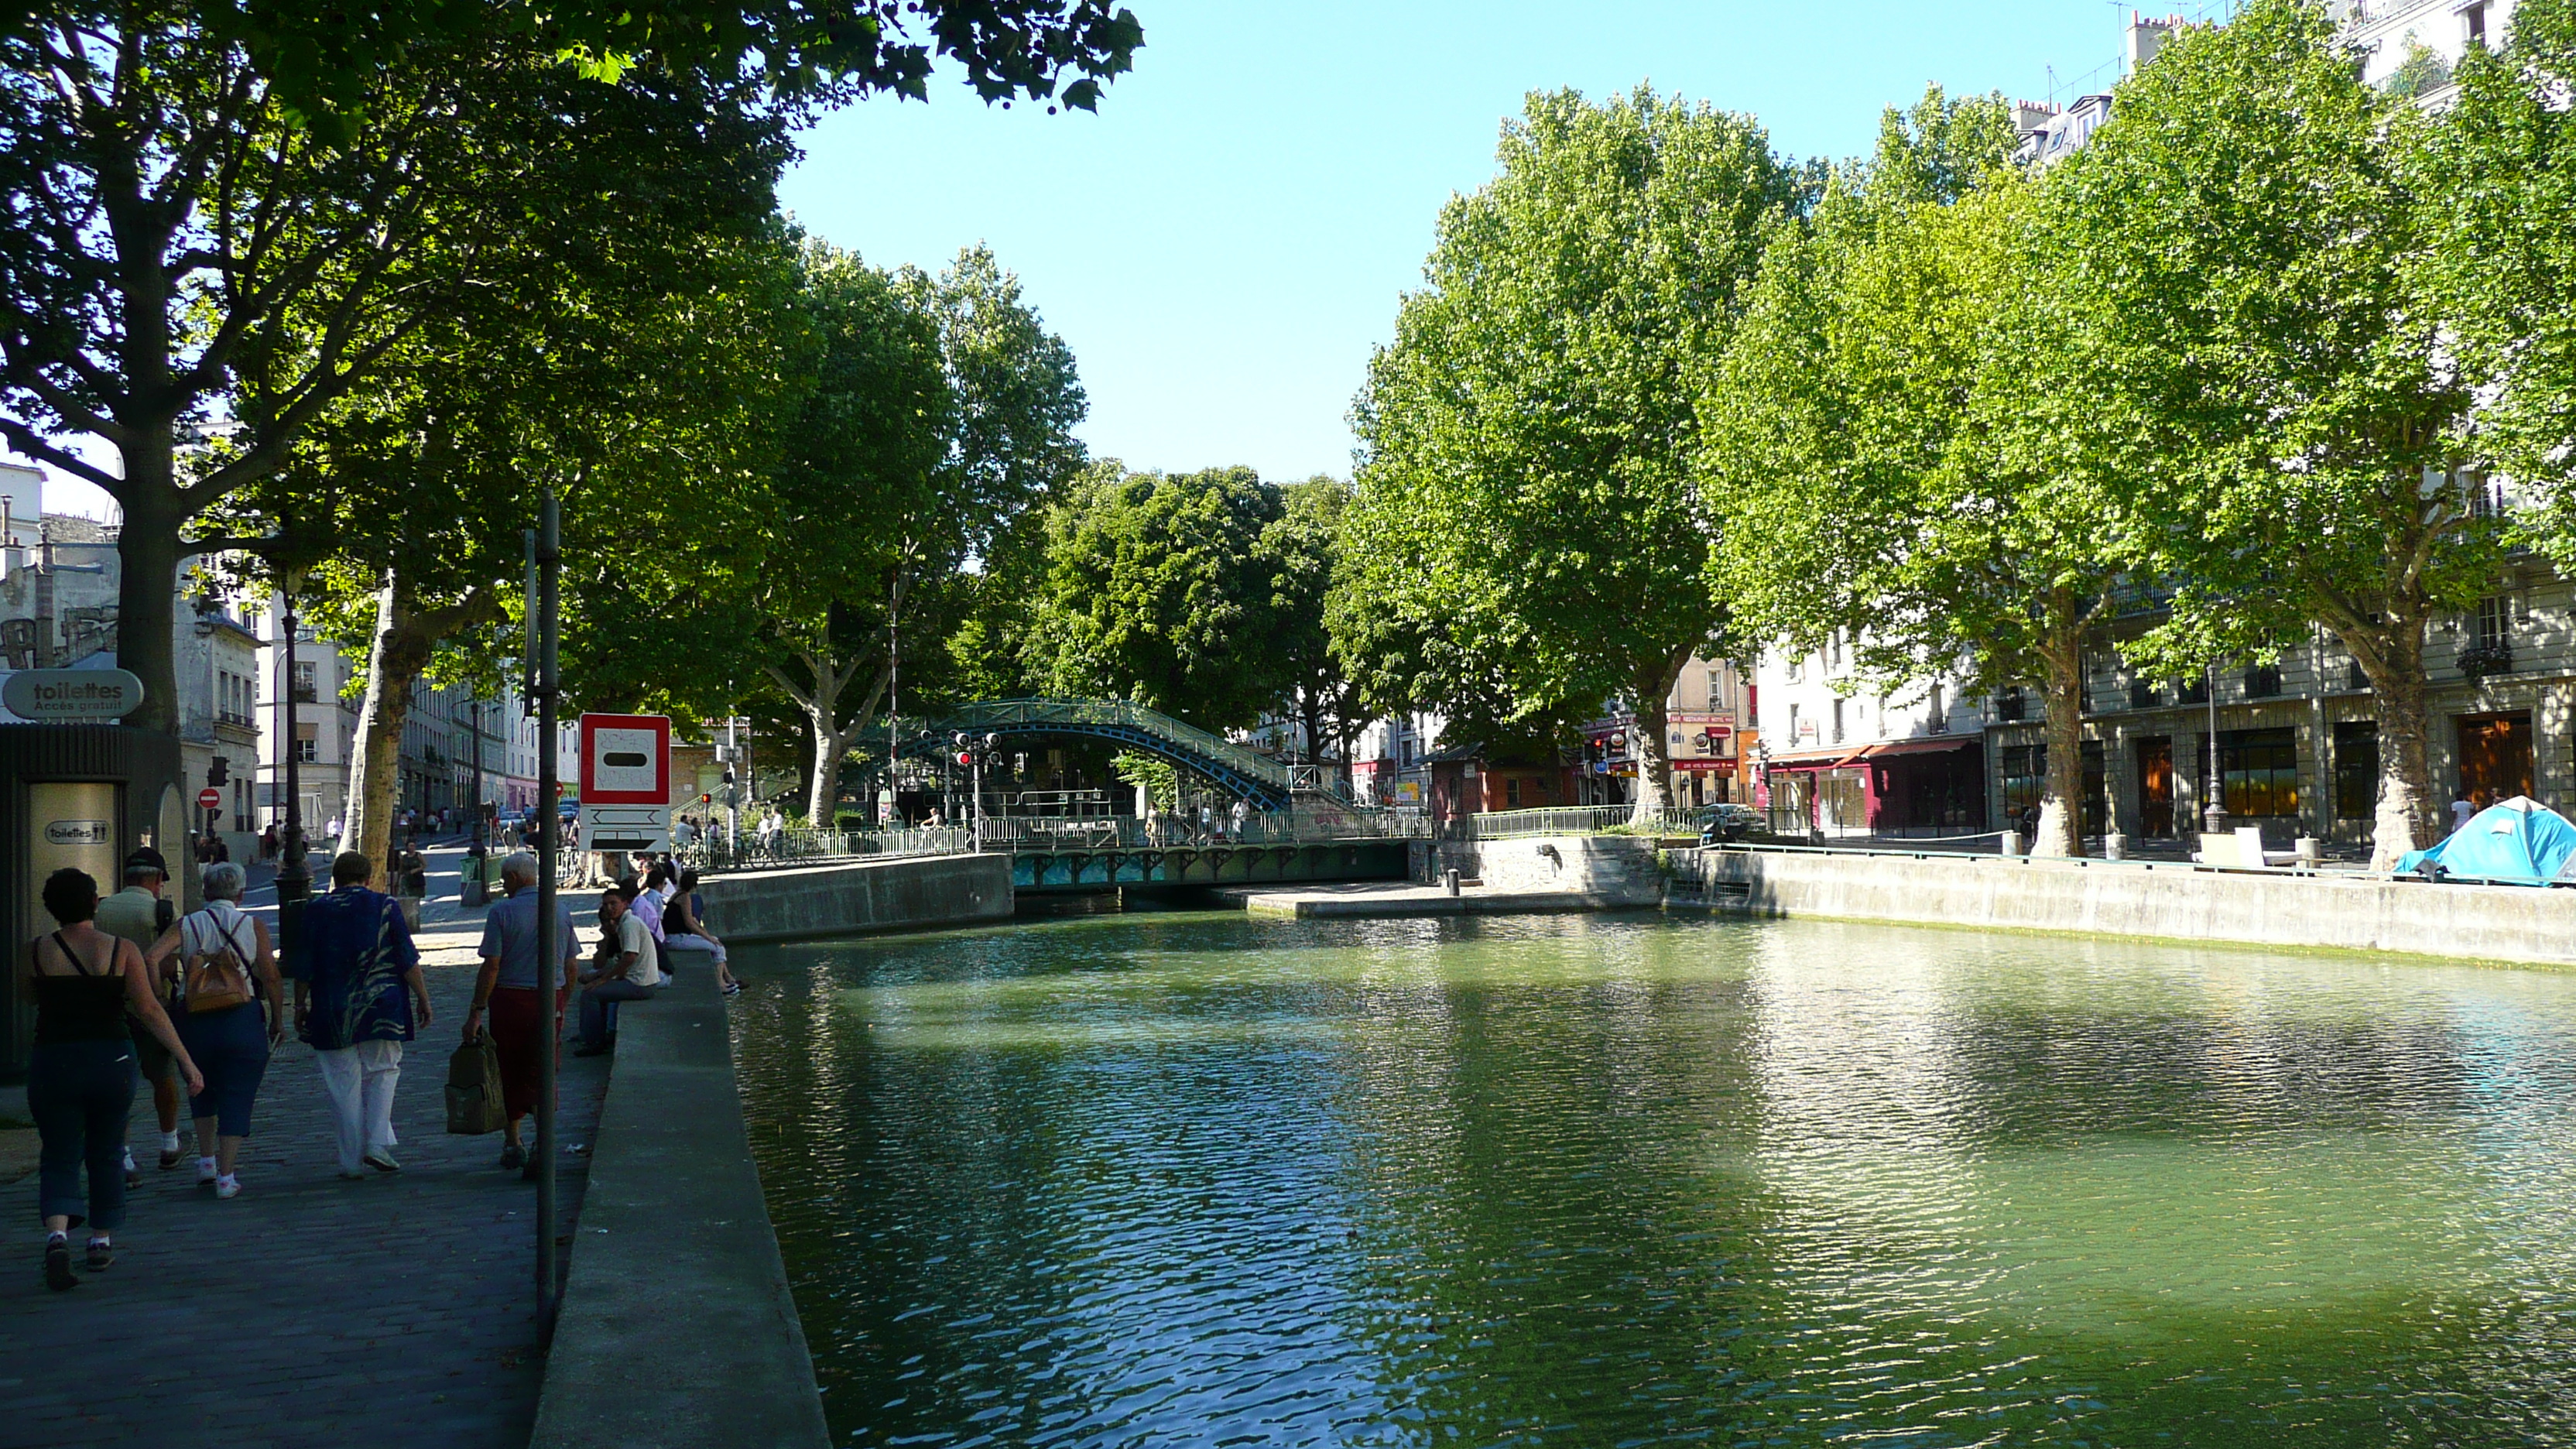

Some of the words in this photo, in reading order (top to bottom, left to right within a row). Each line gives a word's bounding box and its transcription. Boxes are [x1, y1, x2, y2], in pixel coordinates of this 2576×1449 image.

[34, 682, 123, 700] toilettes
[80, 701, 122, 712] gratuit
[50, 827, 91, 838] toilettes
